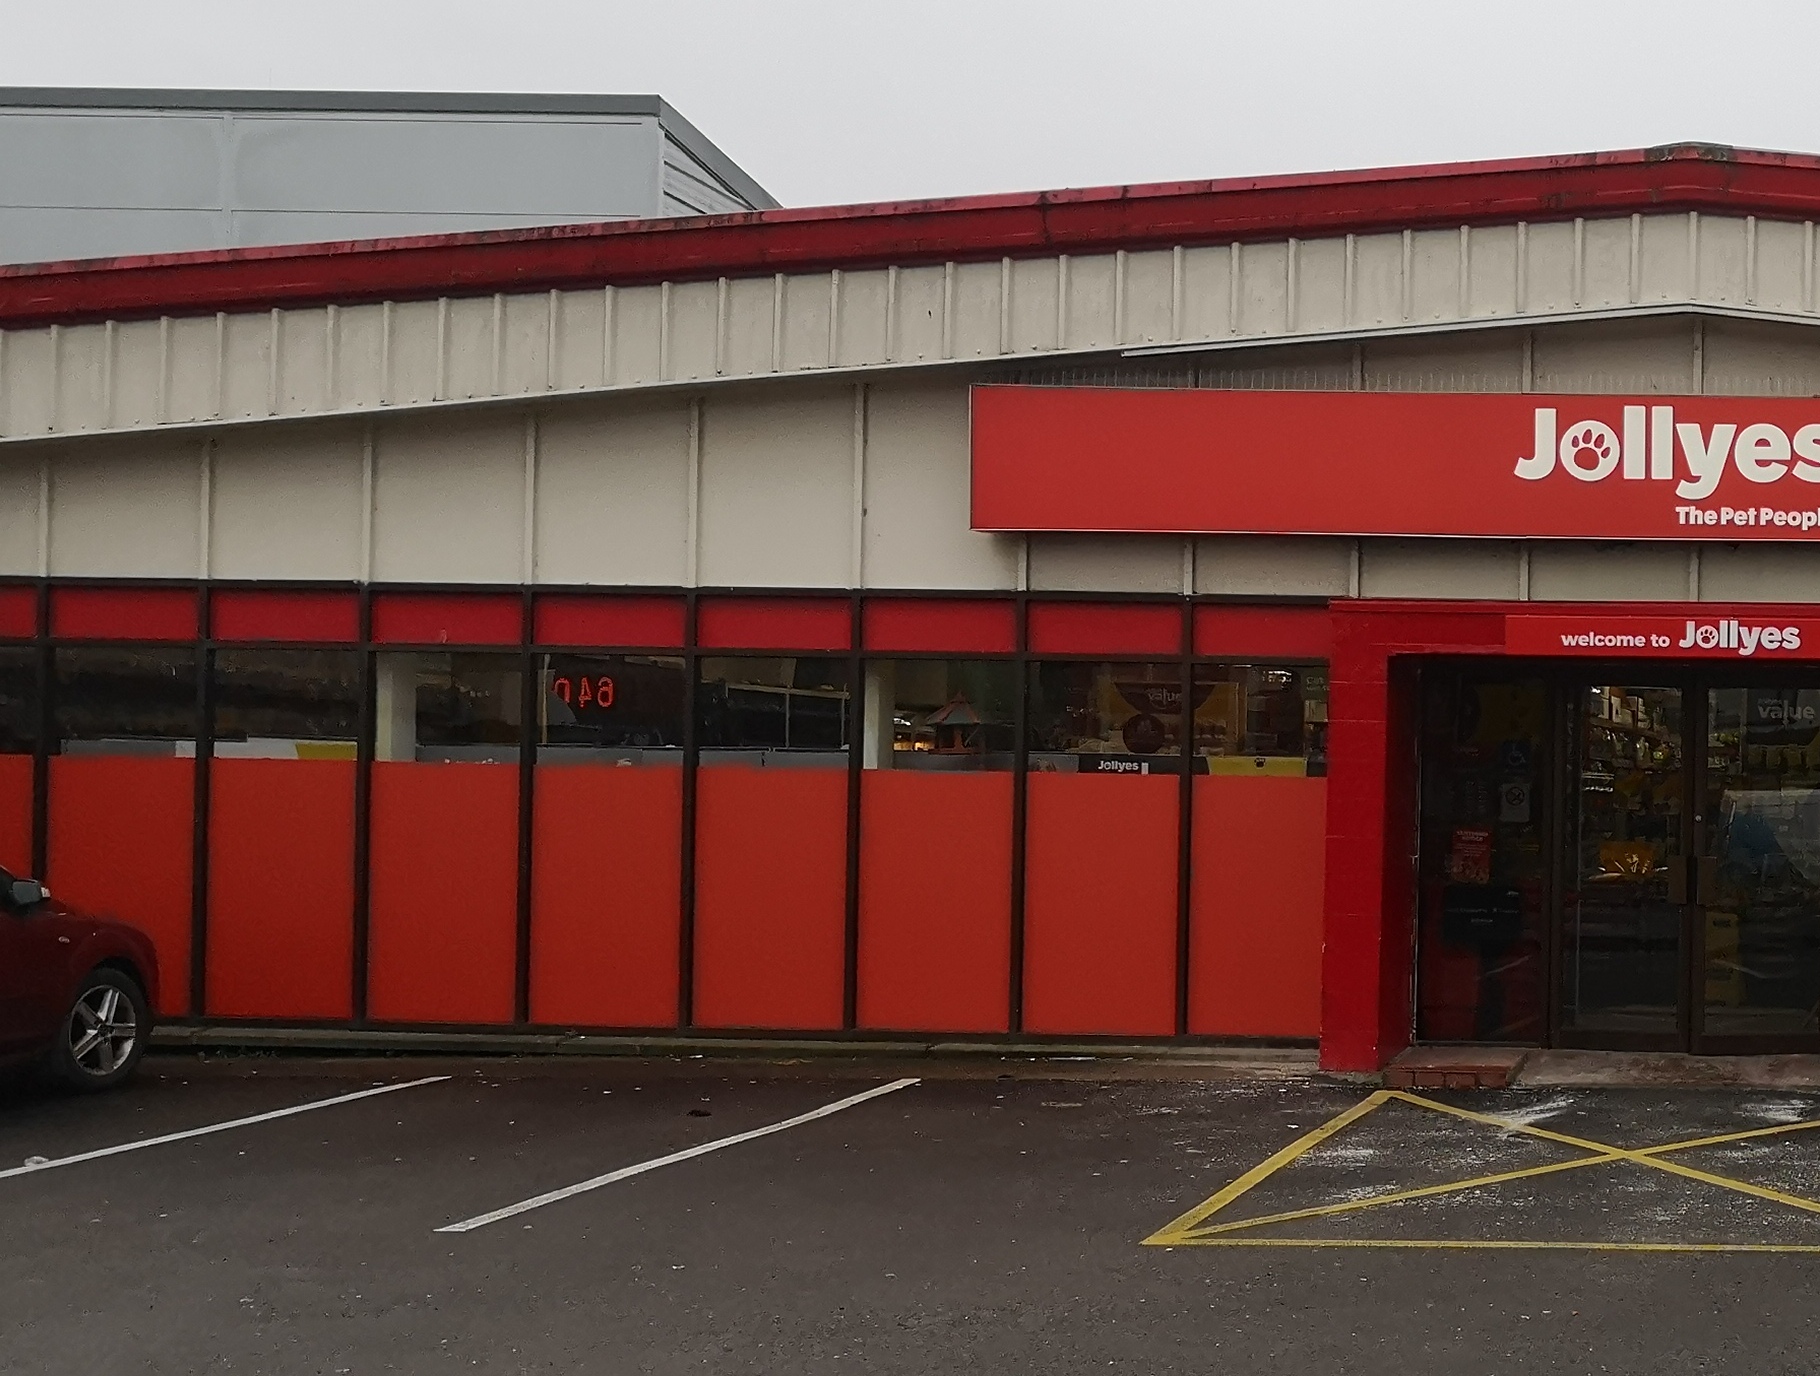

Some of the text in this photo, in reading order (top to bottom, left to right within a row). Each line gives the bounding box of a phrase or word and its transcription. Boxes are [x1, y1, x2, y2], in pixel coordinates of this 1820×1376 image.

[1675, 506, 1717, 526] The
[1720, 506, 1757, 527] Pet
[1560, 620, 1801, 656] welcome to Jollyes
[1757, 699, 1816, 721] value
[1097, 760, 1140, 773] Jollyes
